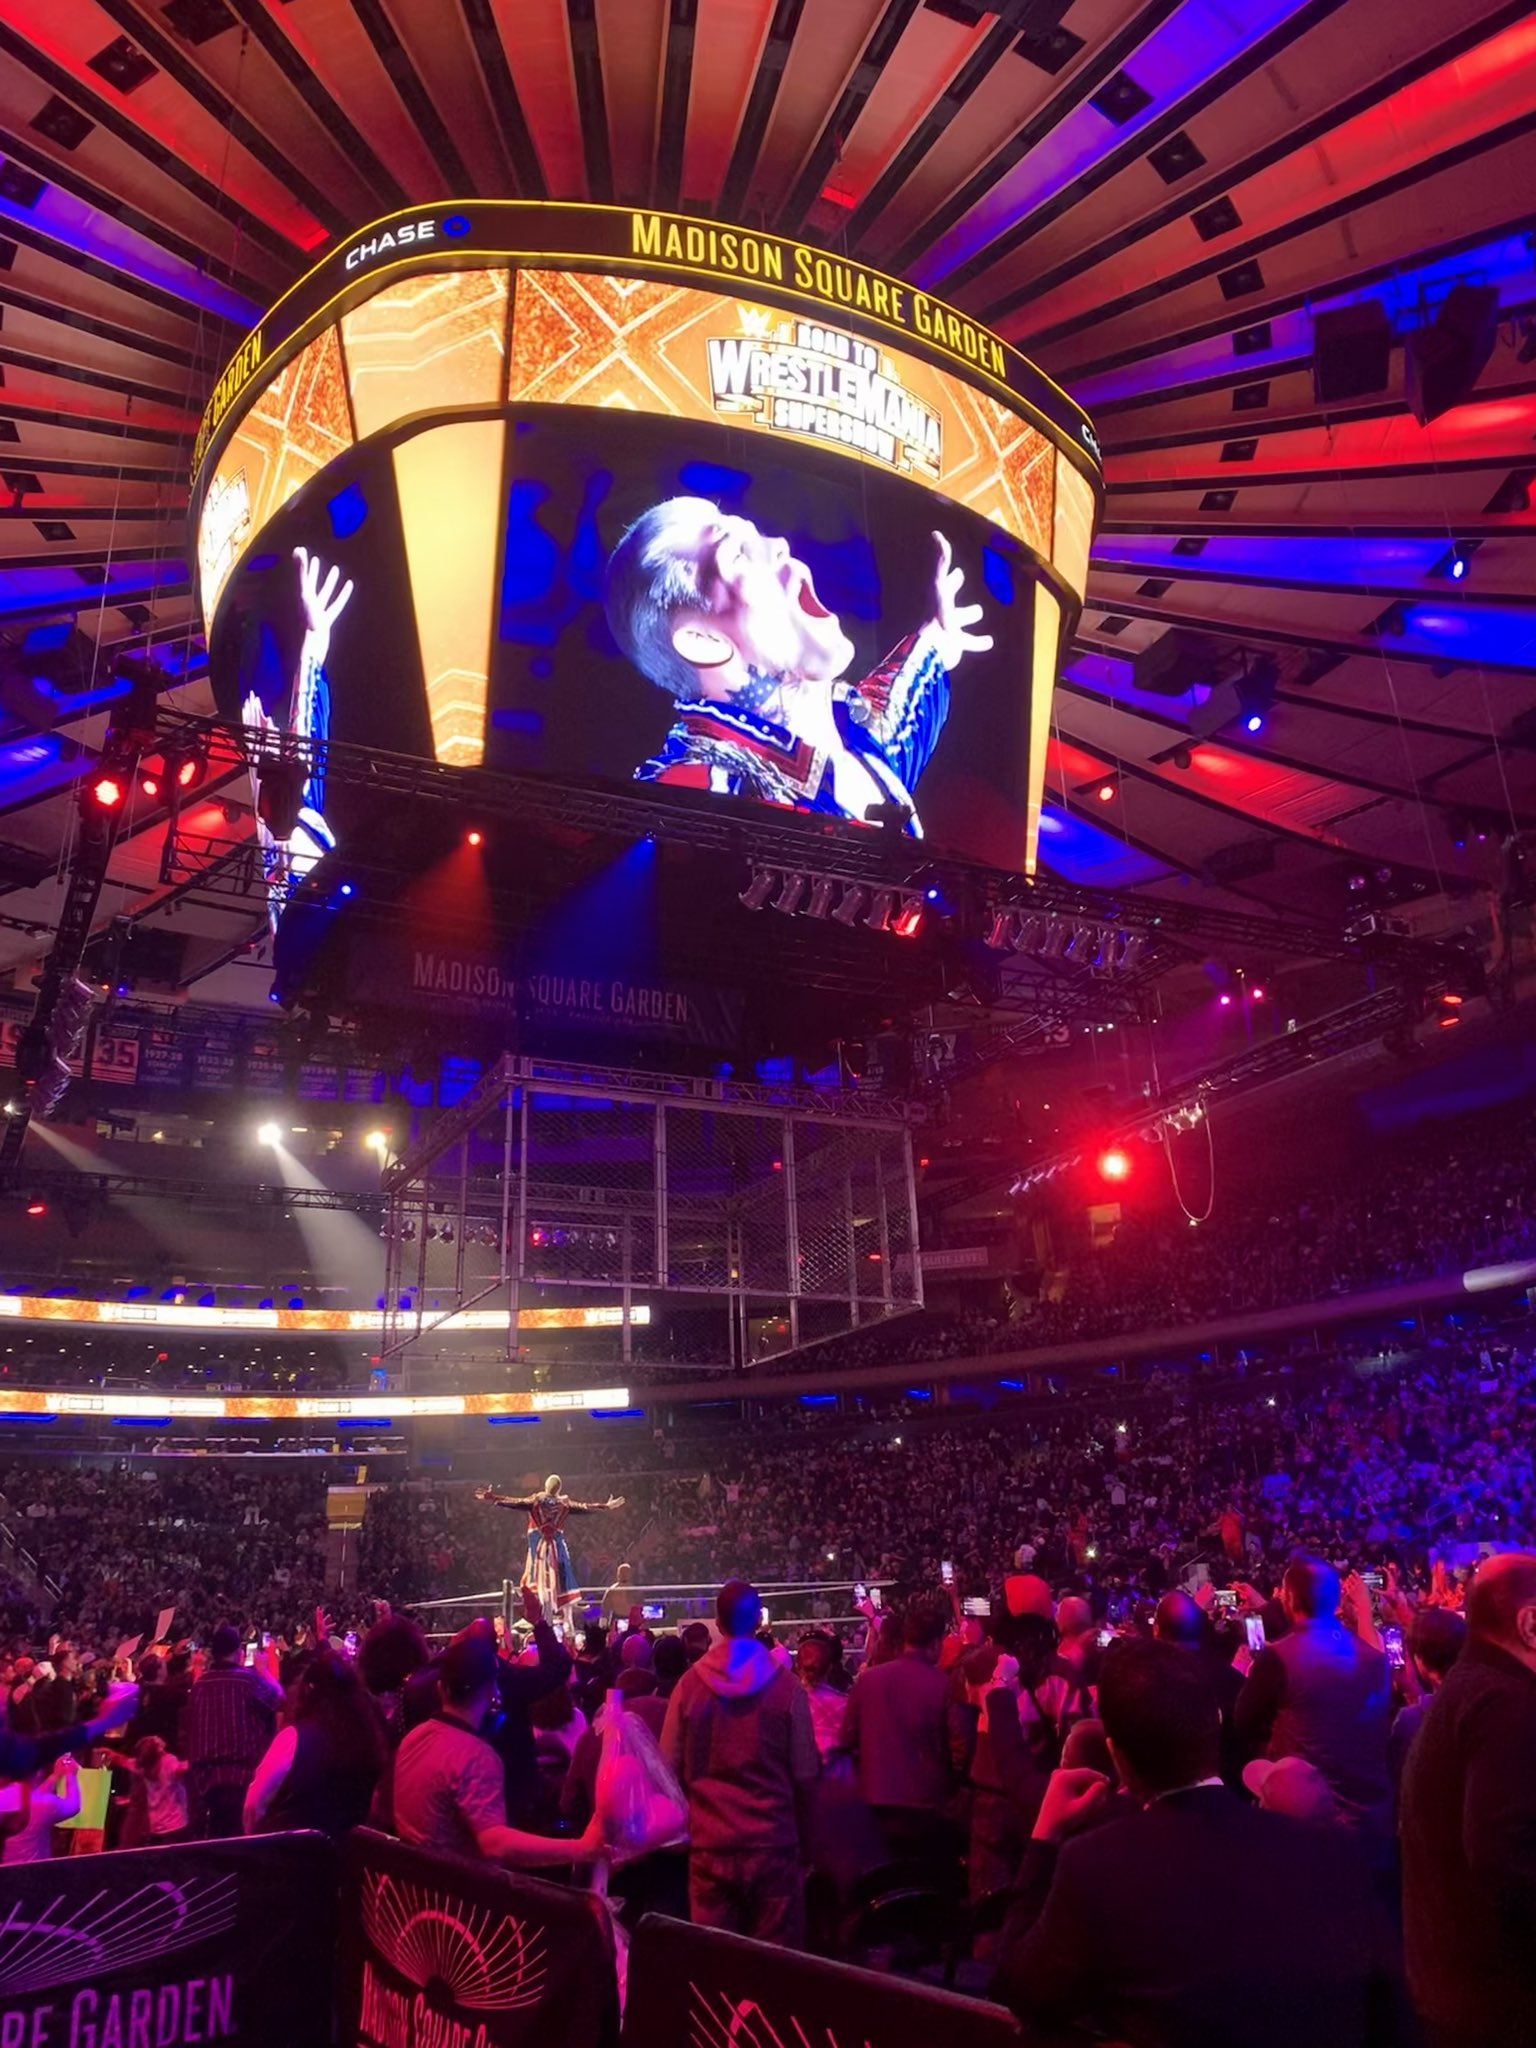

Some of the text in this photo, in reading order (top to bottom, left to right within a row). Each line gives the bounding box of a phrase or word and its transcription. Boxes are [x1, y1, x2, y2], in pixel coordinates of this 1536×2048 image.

[345, 219, 436, 271] CHASE
[632, 213, 1006, 378] MADISON SQUARE GARDEN
[212, 330, 262, 426] GARDEN
[851, 337, 877, 370] TO
[774, 398, 895, 461] SUPERSHOW
[610, 981, 688, 1022] GARDEN
[99, 1037, 135, 1066] 35
[70, 1974, 235, 2048] GARDEN
